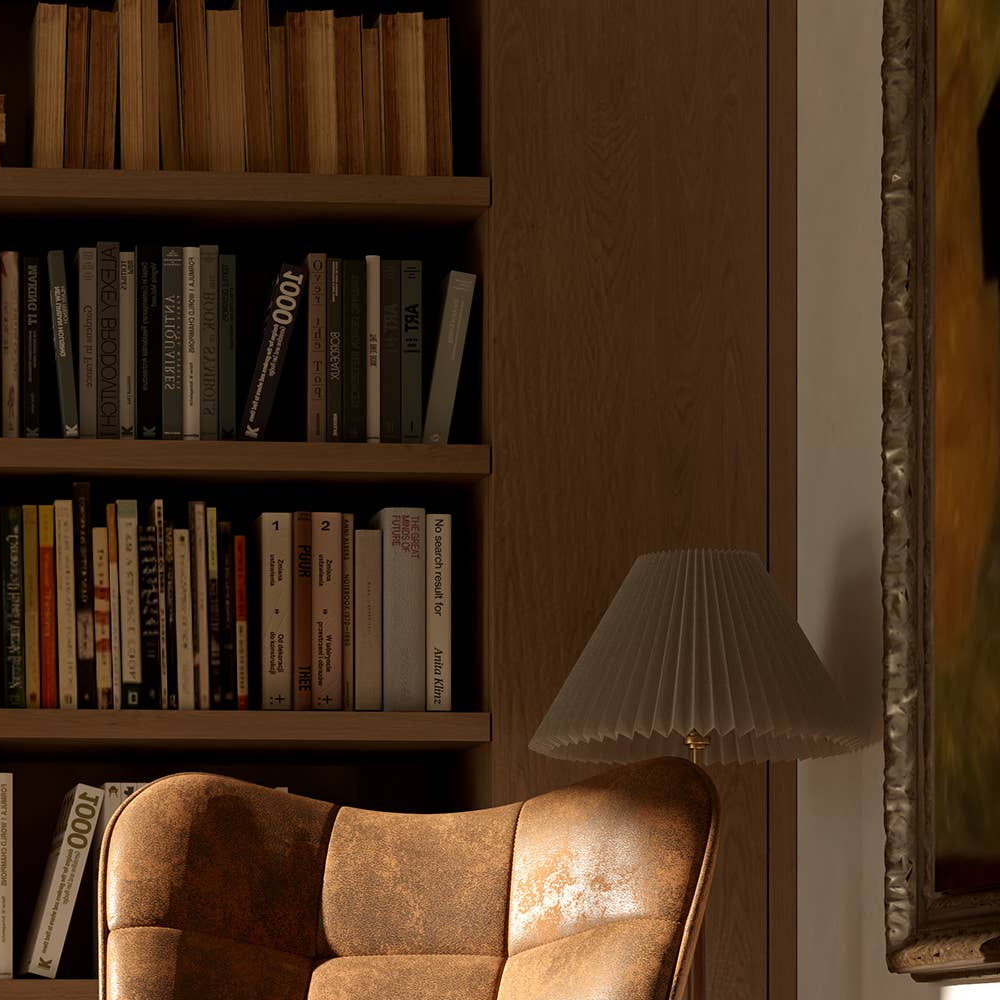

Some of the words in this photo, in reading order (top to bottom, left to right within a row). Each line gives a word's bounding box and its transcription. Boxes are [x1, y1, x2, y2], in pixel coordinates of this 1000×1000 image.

[272, 520, 279, 531] 1
[320, 520, 331, 532] 2
[391, 514, 401, 547] FUTURE
[401, 515, 410, 539] MINDS
[410, 516, 420, 531] THE
[434, 519, 444, 534] No
[401, 542, 410, 554] OF
[410, 532, 420, 559] GREAT
[434, 536, 444, 570] search
[297, 544, 312, 578] PUUR
[434, 571, 444, 599] result
[434, 601, 444, 617] for
[270, 631, 277, 640] do
[278, 633, 284, 643] Od
[268, 640, 277, 675] konstrukcji
[277, 643, 285, 673] dekoracji
[433, 647, 444, 676] Anita
[298, 665, 312, 692] THEE
[433, 678, 444, 705] Klinz
